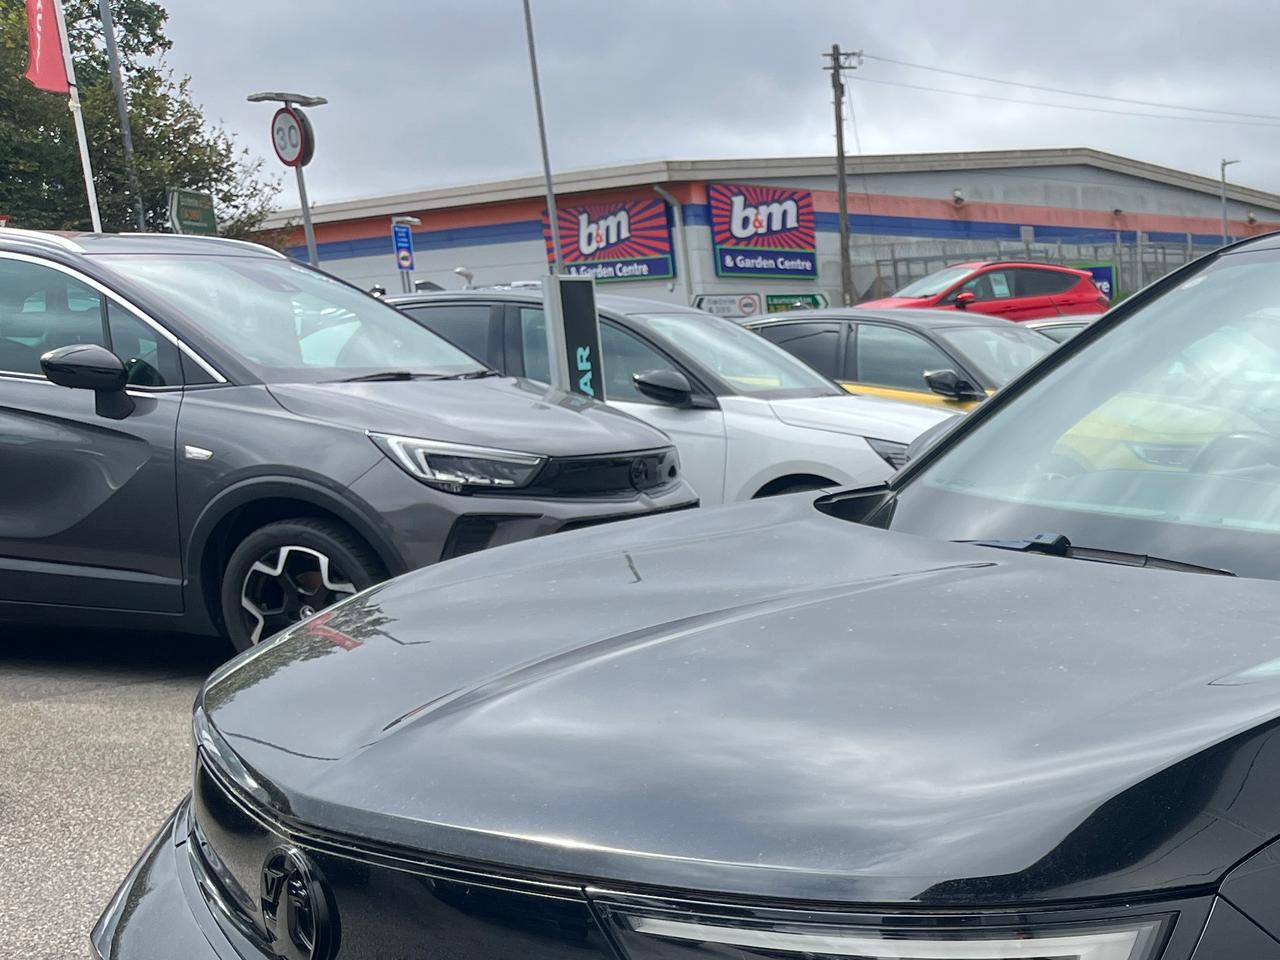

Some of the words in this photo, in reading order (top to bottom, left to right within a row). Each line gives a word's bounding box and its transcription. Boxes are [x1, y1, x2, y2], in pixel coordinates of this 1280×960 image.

[276, 125, 299, 151] 30
[615, 262, 648, 276] Centre
[725, 255, 734, 267] &
[736, 256, 776, 269] Garden
[777, 258, 812, 270] Centre
